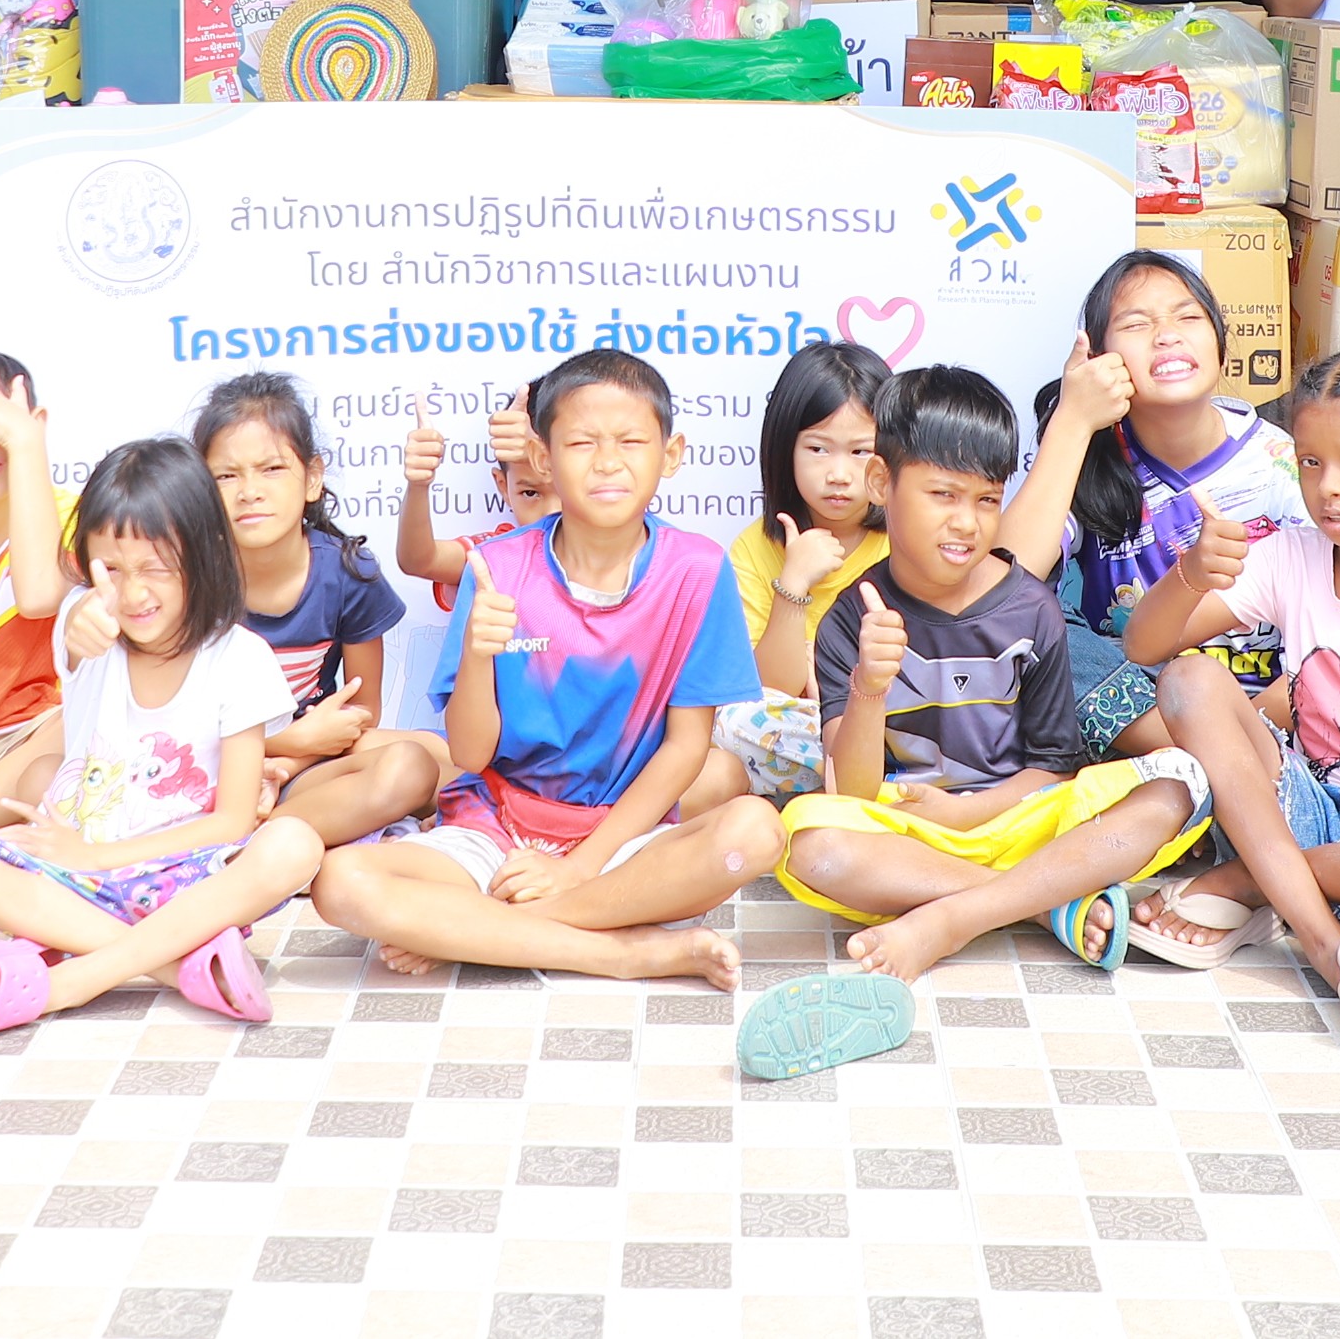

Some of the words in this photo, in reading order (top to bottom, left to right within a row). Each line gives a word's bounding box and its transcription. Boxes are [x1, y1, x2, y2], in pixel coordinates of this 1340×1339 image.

[232, 2, 286, 28] ส่งต่อ
[1195, 113, 1225, 123] OLD
[230, 185, 896, 239] สำนักงานการปฏิรูปที่ดินเพื่อเกษตรกรรม
[1220, 233, 1266, 251] DOZ.
[307, 251, 368, 287] โดย
[382, 250, 800, 289] สำนักวิชาการและแผนงาน
[937, 296, 969, 304] Research
[979, 296, 1010, 306] Planning
[1011, 298, 1037, 306] Bureau
[1220, 303, 1283, 319] แฟ้มตราช้
[168, 307, 579, 362] โครงการส่งของใช้
[1236, 323, 1283, 337] LEVER
[669, 392, 752, 419] ระราม
[505, 637, 550, 653] SPORT
